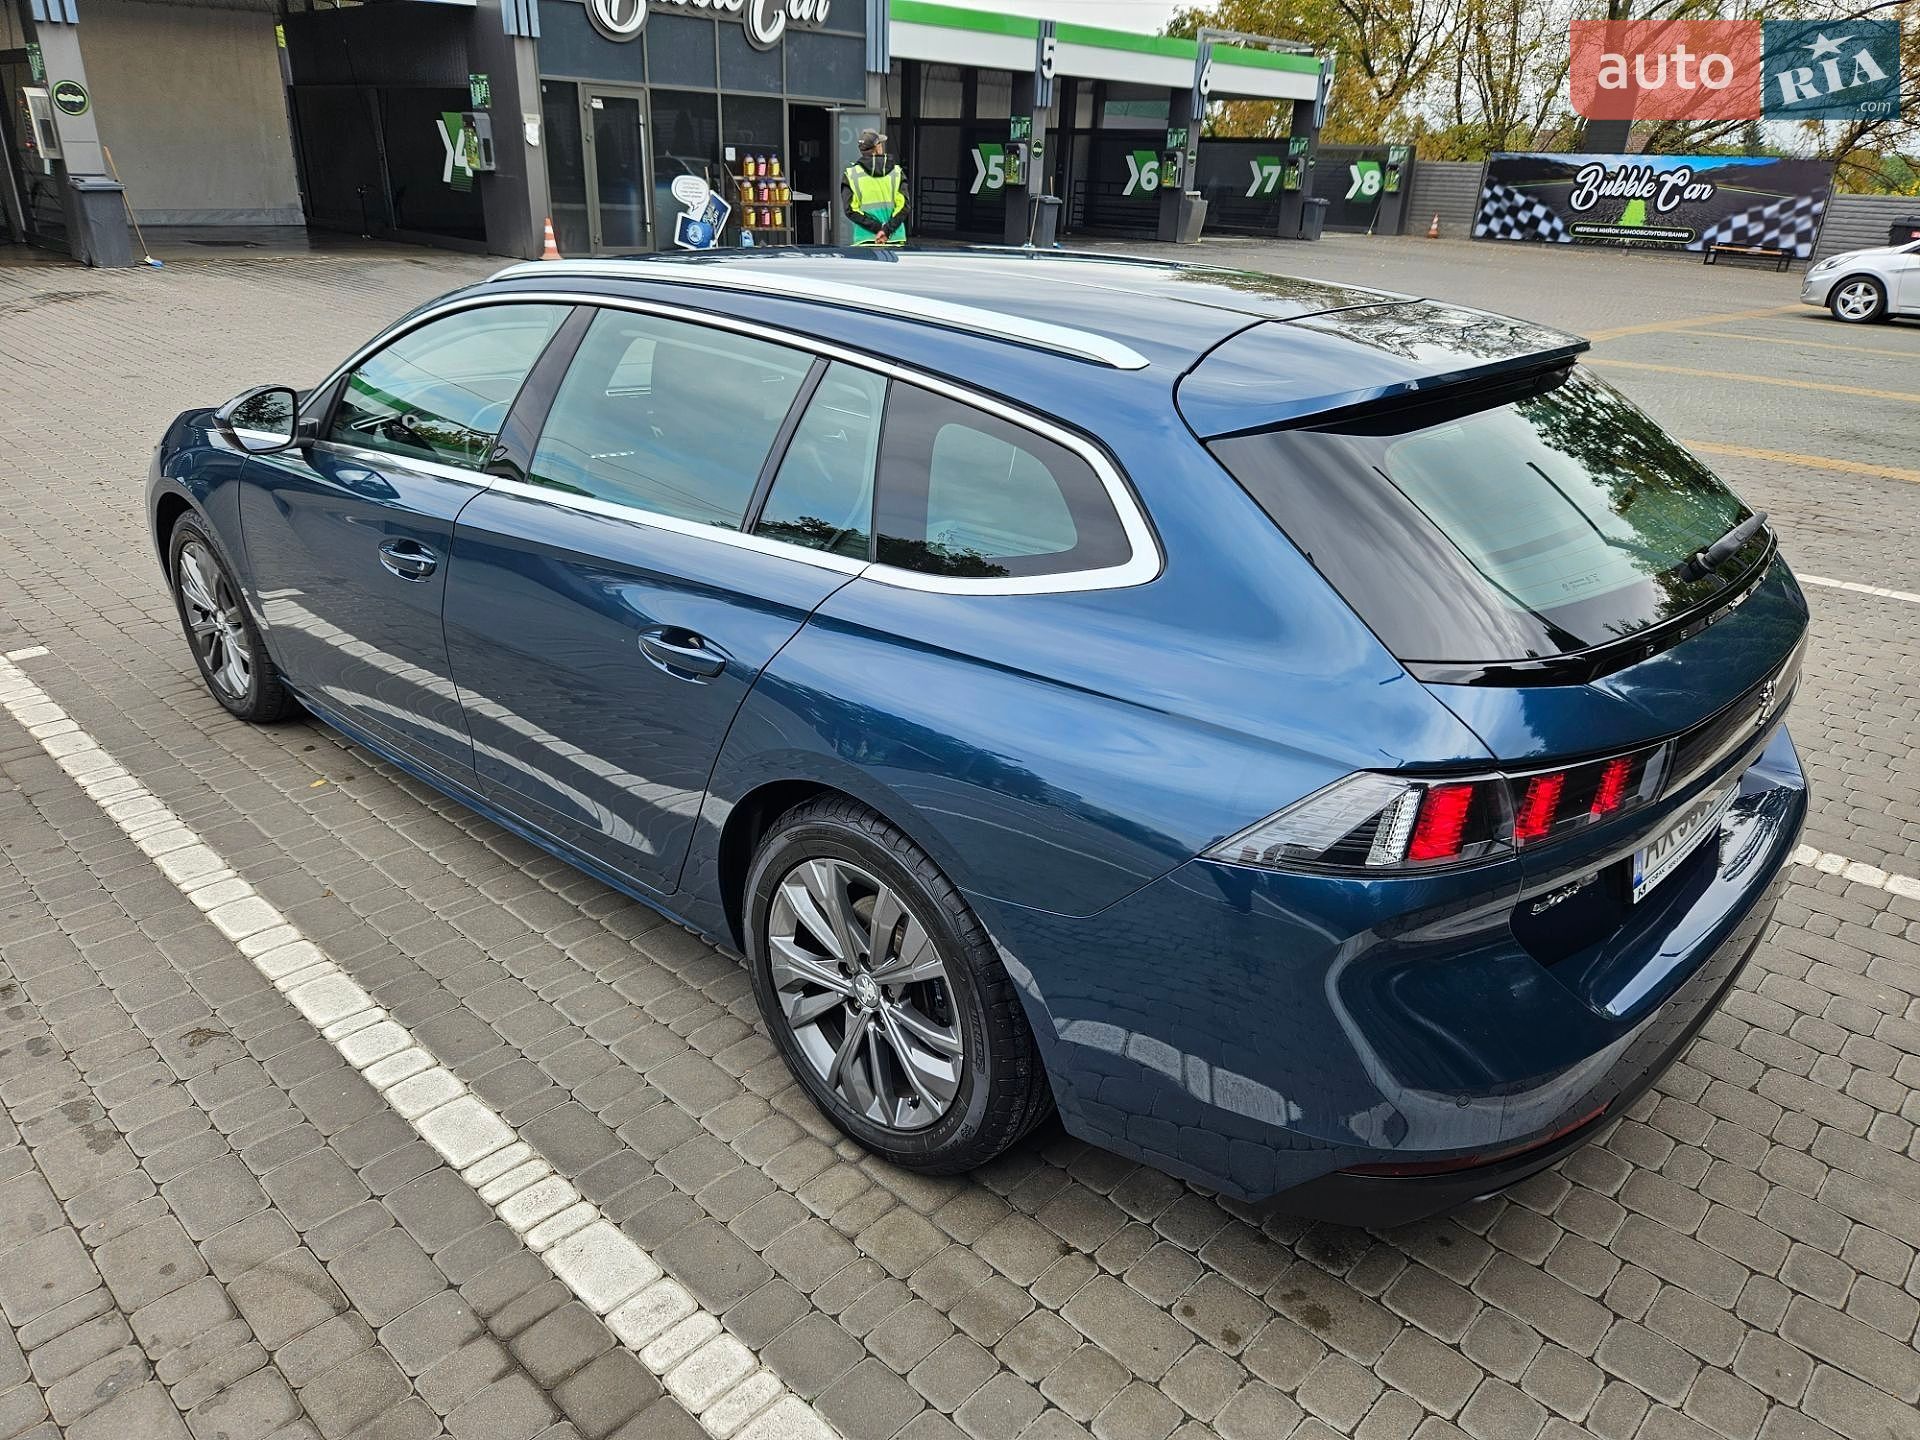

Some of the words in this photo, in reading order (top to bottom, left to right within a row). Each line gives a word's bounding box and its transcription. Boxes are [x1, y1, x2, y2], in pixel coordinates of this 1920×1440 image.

[1041, 37, 1057, 80] 5
[1200, 59, 1213, 96] 6
[454, 128, 474, 177] 4
[986, 155, 1005, 189] 5
[1140, 160, 1160, 191] 6
[1262, 165, 1281, 193] 7
[1361, 170, 1381, 196] 8
[1571, 165, 1656, 211] Bubble
[1657, 168, 1713, 212] Car
